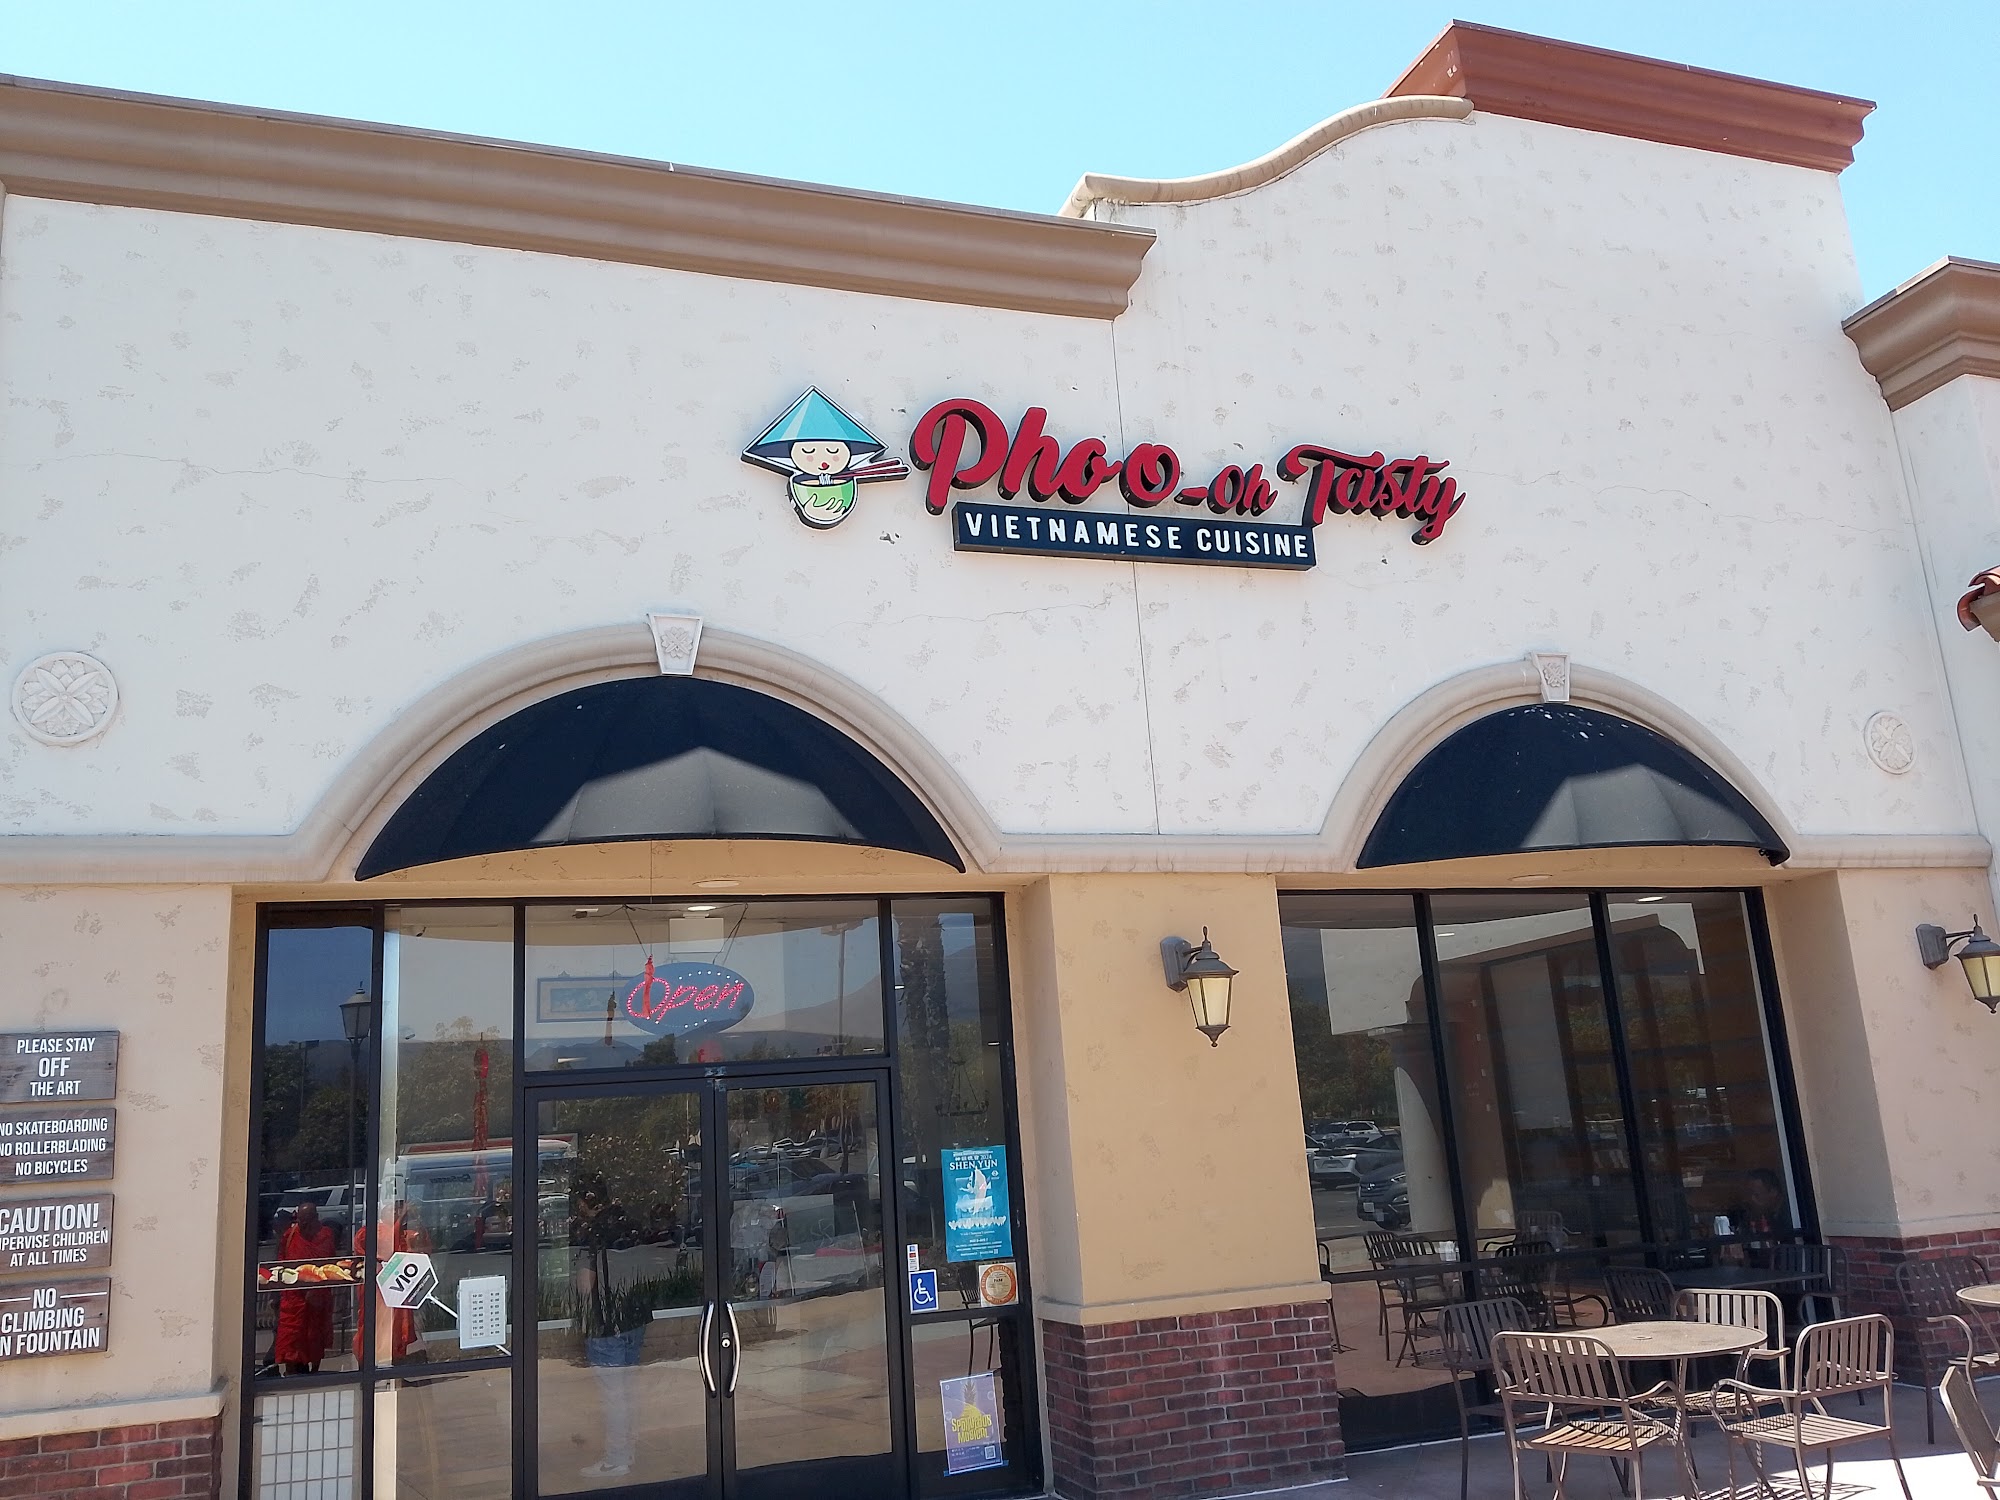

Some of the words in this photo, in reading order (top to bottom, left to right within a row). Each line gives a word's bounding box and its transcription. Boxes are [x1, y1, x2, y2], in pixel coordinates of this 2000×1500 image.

[1277, 444, 1466, 544] Tasty
[965, 512, 1182, 549] VIETNAMESE
[1196, 528, 1309, 558] CUISINE
[627, 976, 745, 1024] Open
[16, 1038, 63, 1054] PLEASE
[65, 1037, 96, 1052] STAY
[38, 1057, 71, 1078] OFF
[30, 1081, 54, 1096] THE
[56, 1080, 81, 1095] ART
[15, 1118, 108, 1136] SKATEBOARDING
[15, 1138, 106, 1155] ROLLERBLADING
[15, 1161, 32, 1176] NO
[34, 1159, 88, 1175] BICYCLES
[949, 1161, 975, 1171] SHEN
[977, 1159, 998, 1169] YUN
[0, 1203, 99, 1235] CAUTION!
[0, 1233, 50, 1251] PERVISE
[52, 1229, 109, 1247] CHILDREN
[10, 1252, 25, 1267] AT
[27, 1251, 49, 1266] ALL
[52, 1248, 87, 1264] TIMES
[32, 1288, 57, 1310] NO
[1, 1306, 85, 1334] CLIMBING
[0, 1335, 12, 1356] N
[16, 1327, 100, 1355] FOUNTAIN
